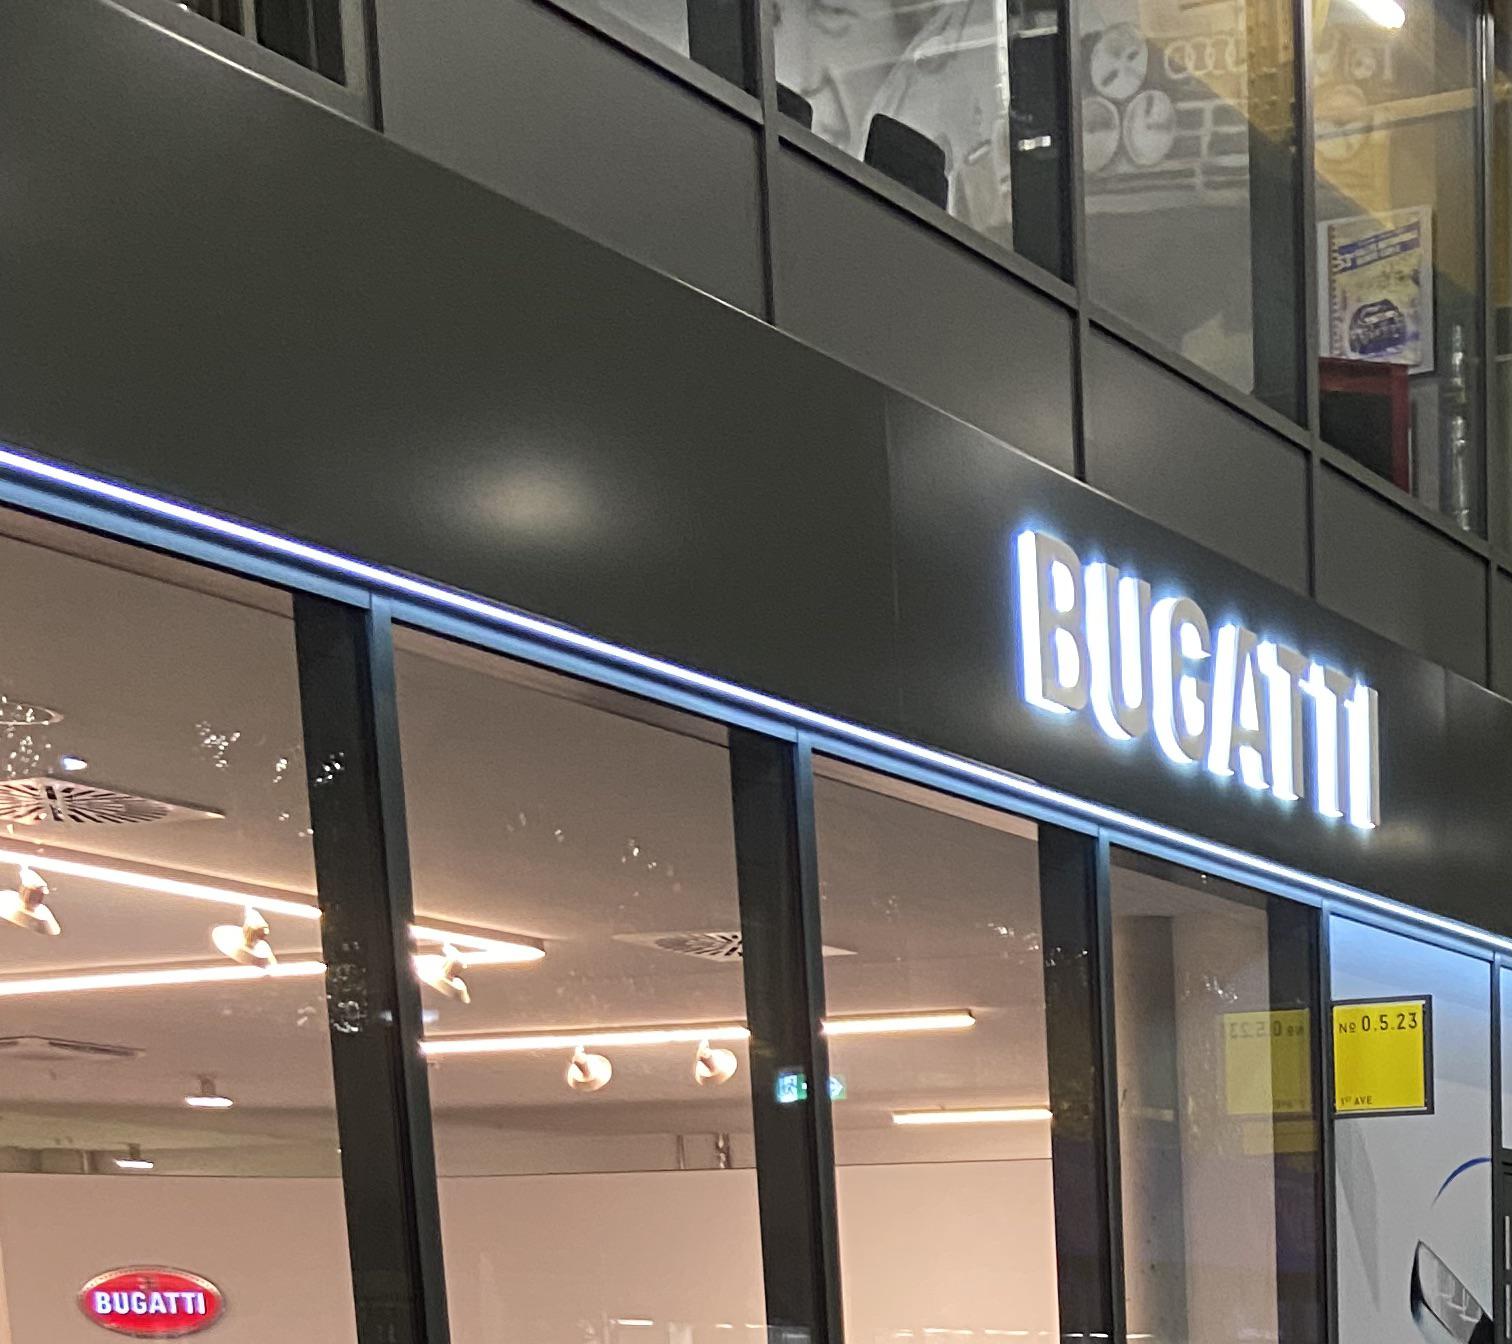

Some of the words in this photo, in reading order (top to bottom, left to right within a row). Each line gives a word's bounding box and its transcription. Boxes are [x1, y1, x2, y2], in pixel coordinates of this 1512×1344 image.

[1015, 529, 1381, 830] BUGATTI
[1361, 1012, 1418, 1032] 0.5.23
[1354, 1095, 1373, 1105] AVE
[93, 1290, 207, 1316] BUGATTI
